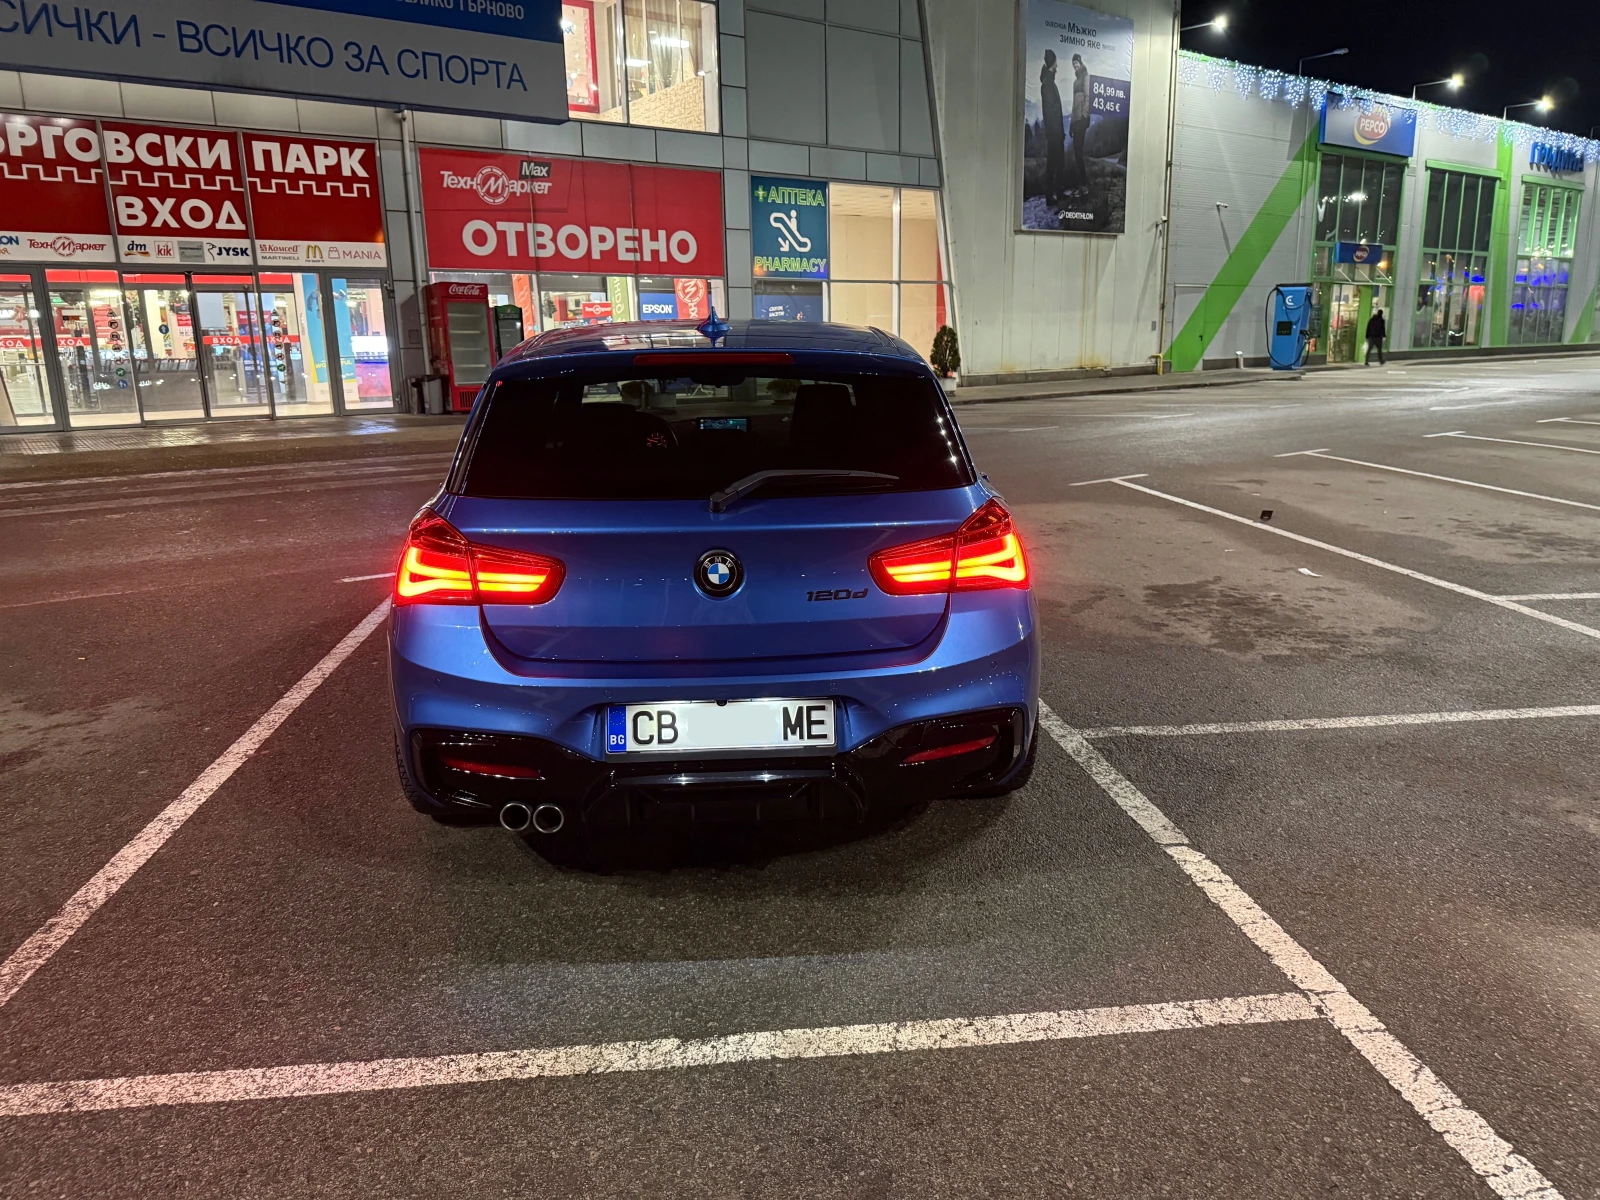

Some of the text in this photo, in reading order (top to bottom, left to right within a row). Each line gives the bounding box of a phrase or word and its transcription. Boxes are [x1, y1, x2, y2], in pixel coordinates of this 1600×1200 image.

[459, 0, 525, 20] ТЪРНОВО
[1067, 22, 1097, 37] Мъжко
[1087, 39, 1101, 50] яке
[176, 19, 334, 68] ВСИЧКО
[343, 41, 390, 76] ЗА
[397, 48, 528, 92] СПОРТА
[1092, 82, 1126, 99] 84,99 лв.
[1092, 97, 1115, 112] 43,45
[1360, 117, 1385, 134] PEPCO
[0, 122, 369, 178] РГОВСКИ ПАРК
[521, 161, 548, 178] Max
[767, 186, 826, 207] АПТЕКА
[115, 195, 246, 231] ВХОД
[1065, 211, 1094, 220] DECATHLON
[0, 235, 20, 246] ON
[127, 240, 147, 252] dm
[462, 219, 698, 264] ОТВОРЕНО
[216, 246, 250, 257] JYSK
[342, 249, 382, 260] MANIA
[754, 256, 827, 273] PHARMACY
[642, 303, 673, 314] EPSON
[0, 339, 24, 348] ХОД
[59, 338, 85, 347] ХОД
[212, 336, 242, 345] ВХОД
[703, 556, 734, 569] BMW
[806, 587, 869, 602] 120d
[632, 704, 828, 745] CB ME
[609, 734, 625, 746] BG
